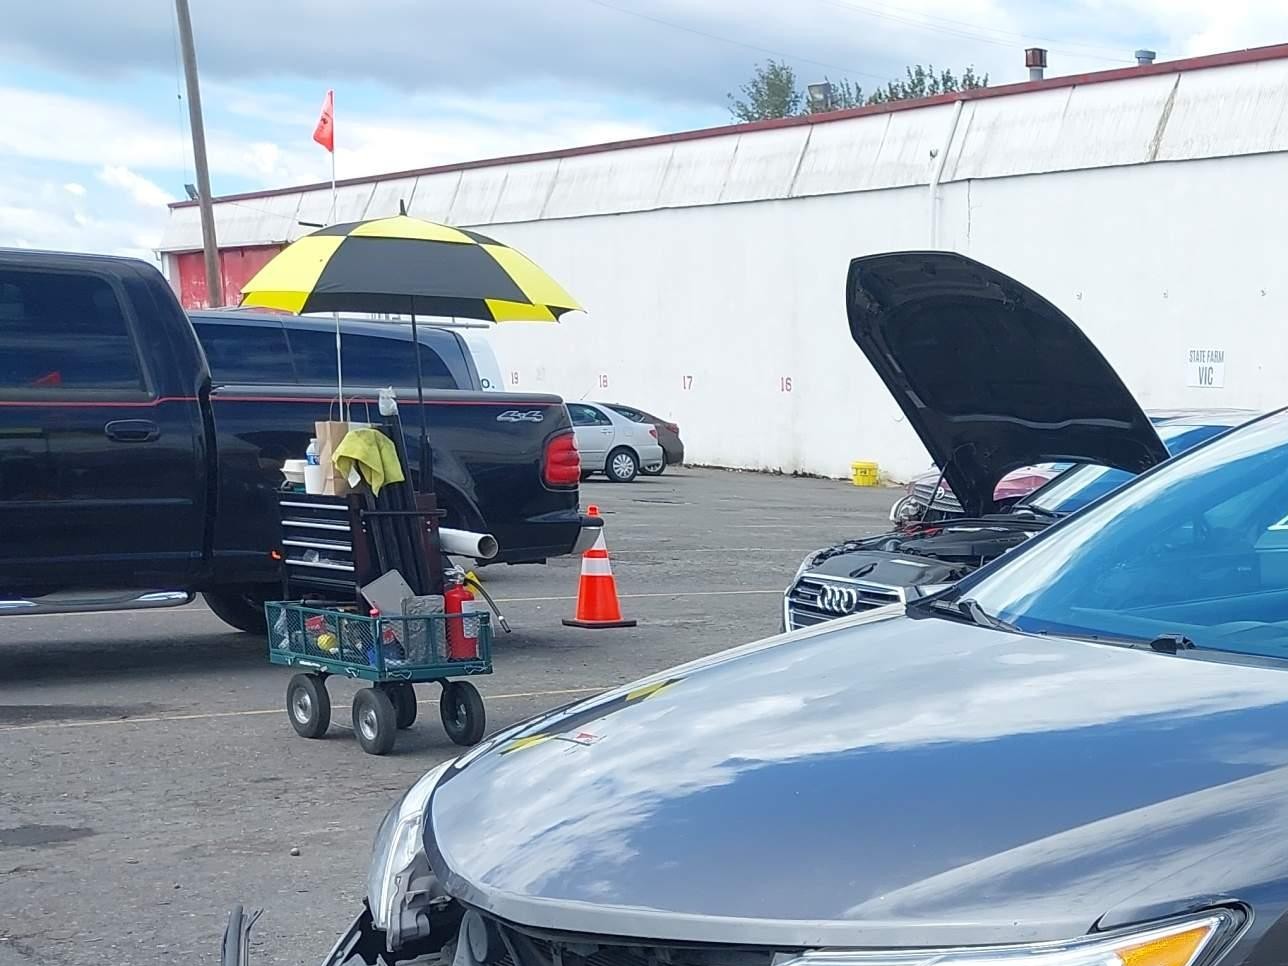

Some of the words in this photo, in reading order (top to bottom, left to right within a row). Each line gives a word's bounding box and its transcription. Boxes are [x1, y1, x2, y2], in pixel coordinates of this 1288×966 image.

[1189, 351, 1205, 363] STATE
[1206, 351, 1225, 363] FARM
[511, 371, 519, 385] 19
[598, 374, 609, 388] 18
[682, 374, 694, 390] 17
[1198, 366, 1214, 385] VIC
[780, 376, 792, 392] 16
